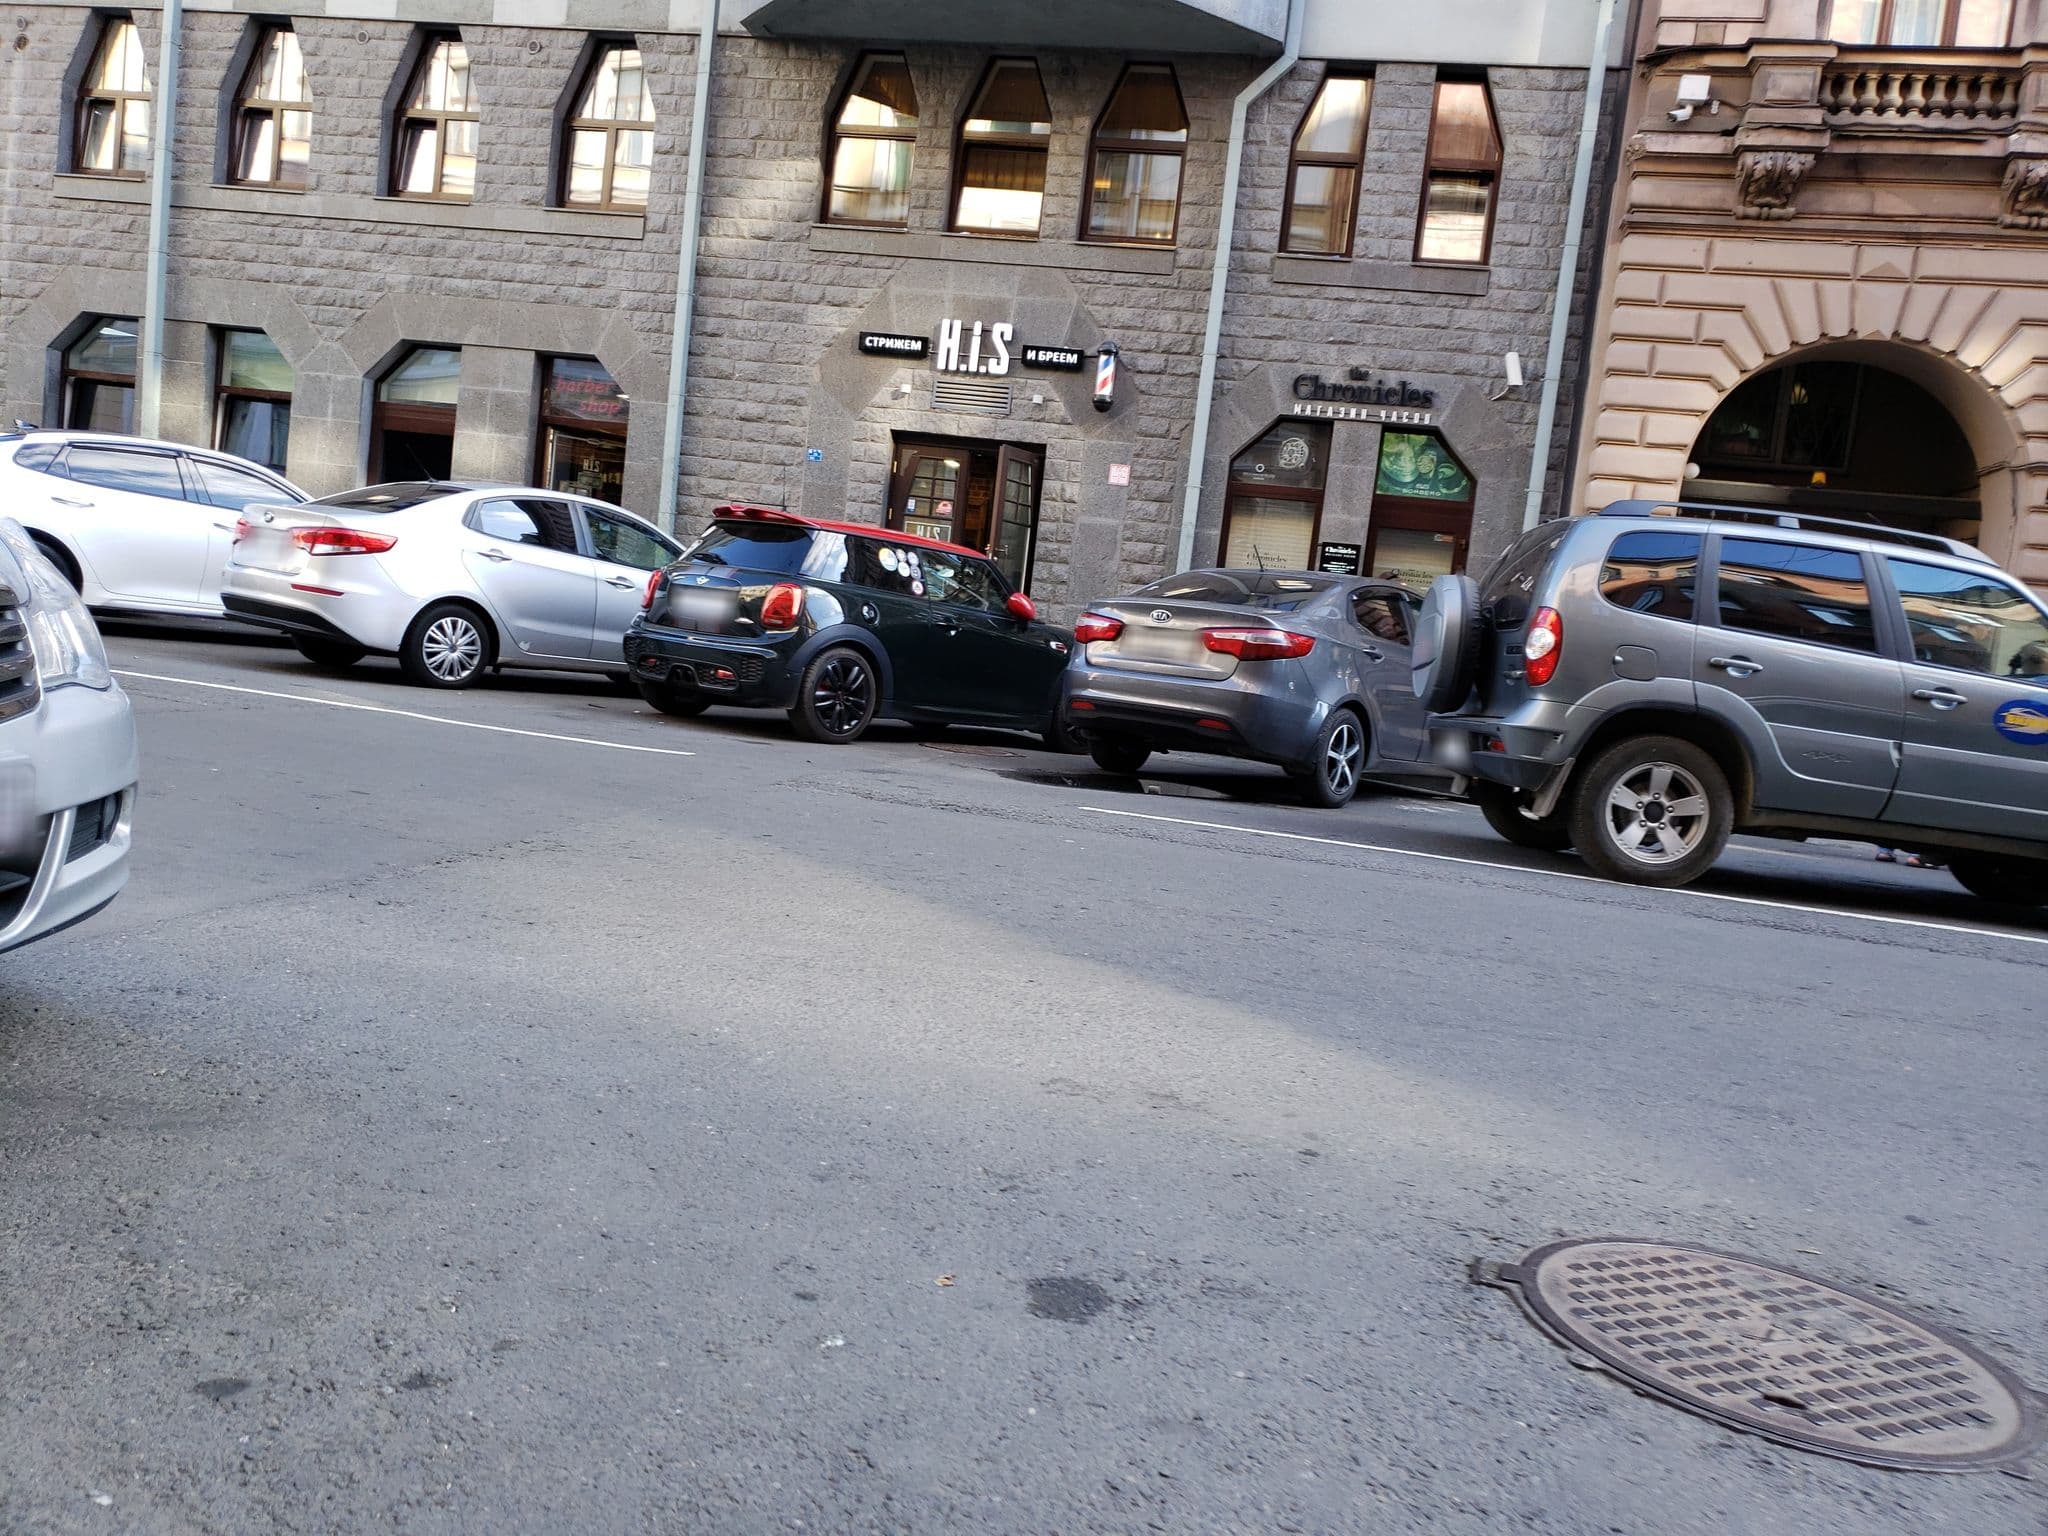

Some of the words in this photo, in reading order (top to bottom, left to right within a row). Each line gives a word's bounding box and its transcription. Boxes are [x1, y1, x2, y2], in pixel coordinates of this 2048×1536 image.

[865, 336, 922, 350] СТРИЖЕМ
[1026, 350, 1036, 360] И
[1038, 350, 1078, 364] БРЕЕМ
[1293, 373, 1434, 408] Chronicles
[1293, 403, 1368, 420] МАГАЗИН
[1380, 409, 1432, 425] ЧАСОВ
